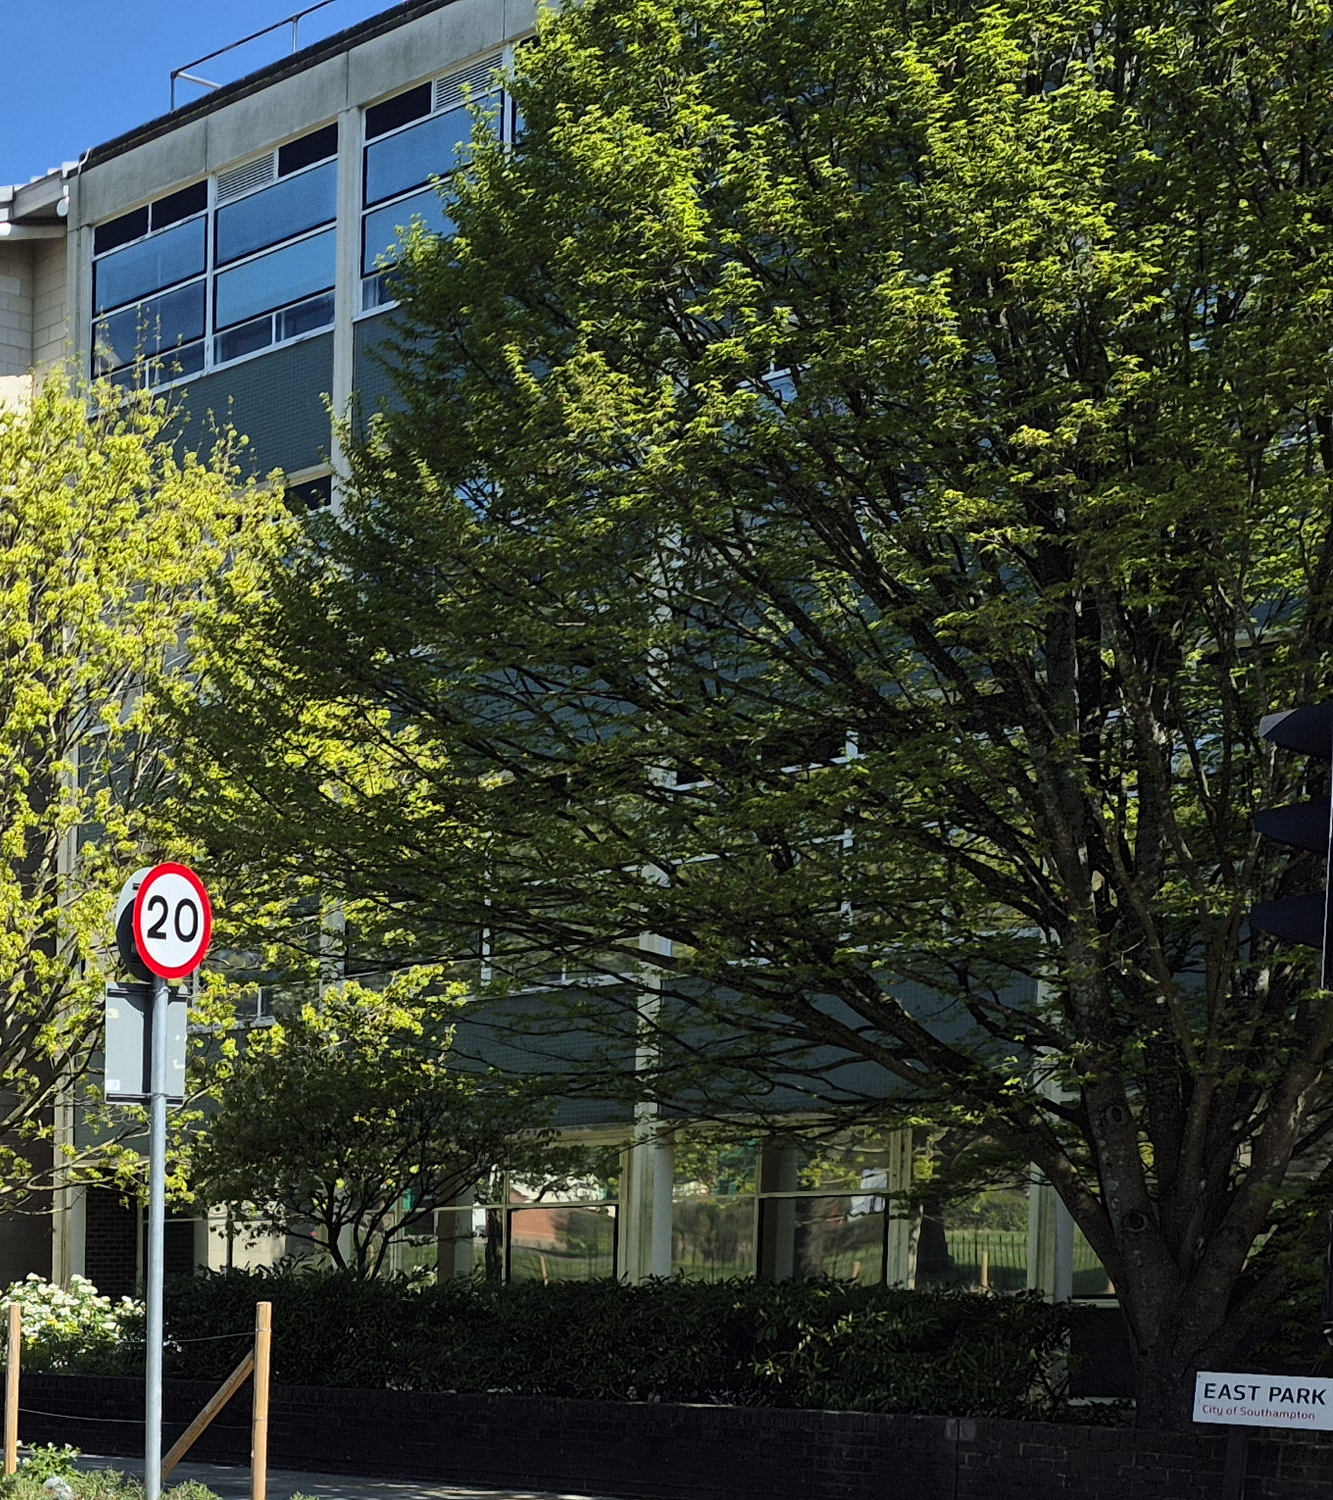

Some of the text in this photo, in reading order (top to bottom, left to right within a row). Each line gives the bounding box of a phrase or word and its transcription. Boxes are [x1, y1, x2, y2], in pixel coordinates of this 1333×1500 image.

[146, 895, 199, 943] 20
[1203, 1382, 1327, 1406] EAST PARK
[1202, 1404, 1316, 1420] City of Southampton
